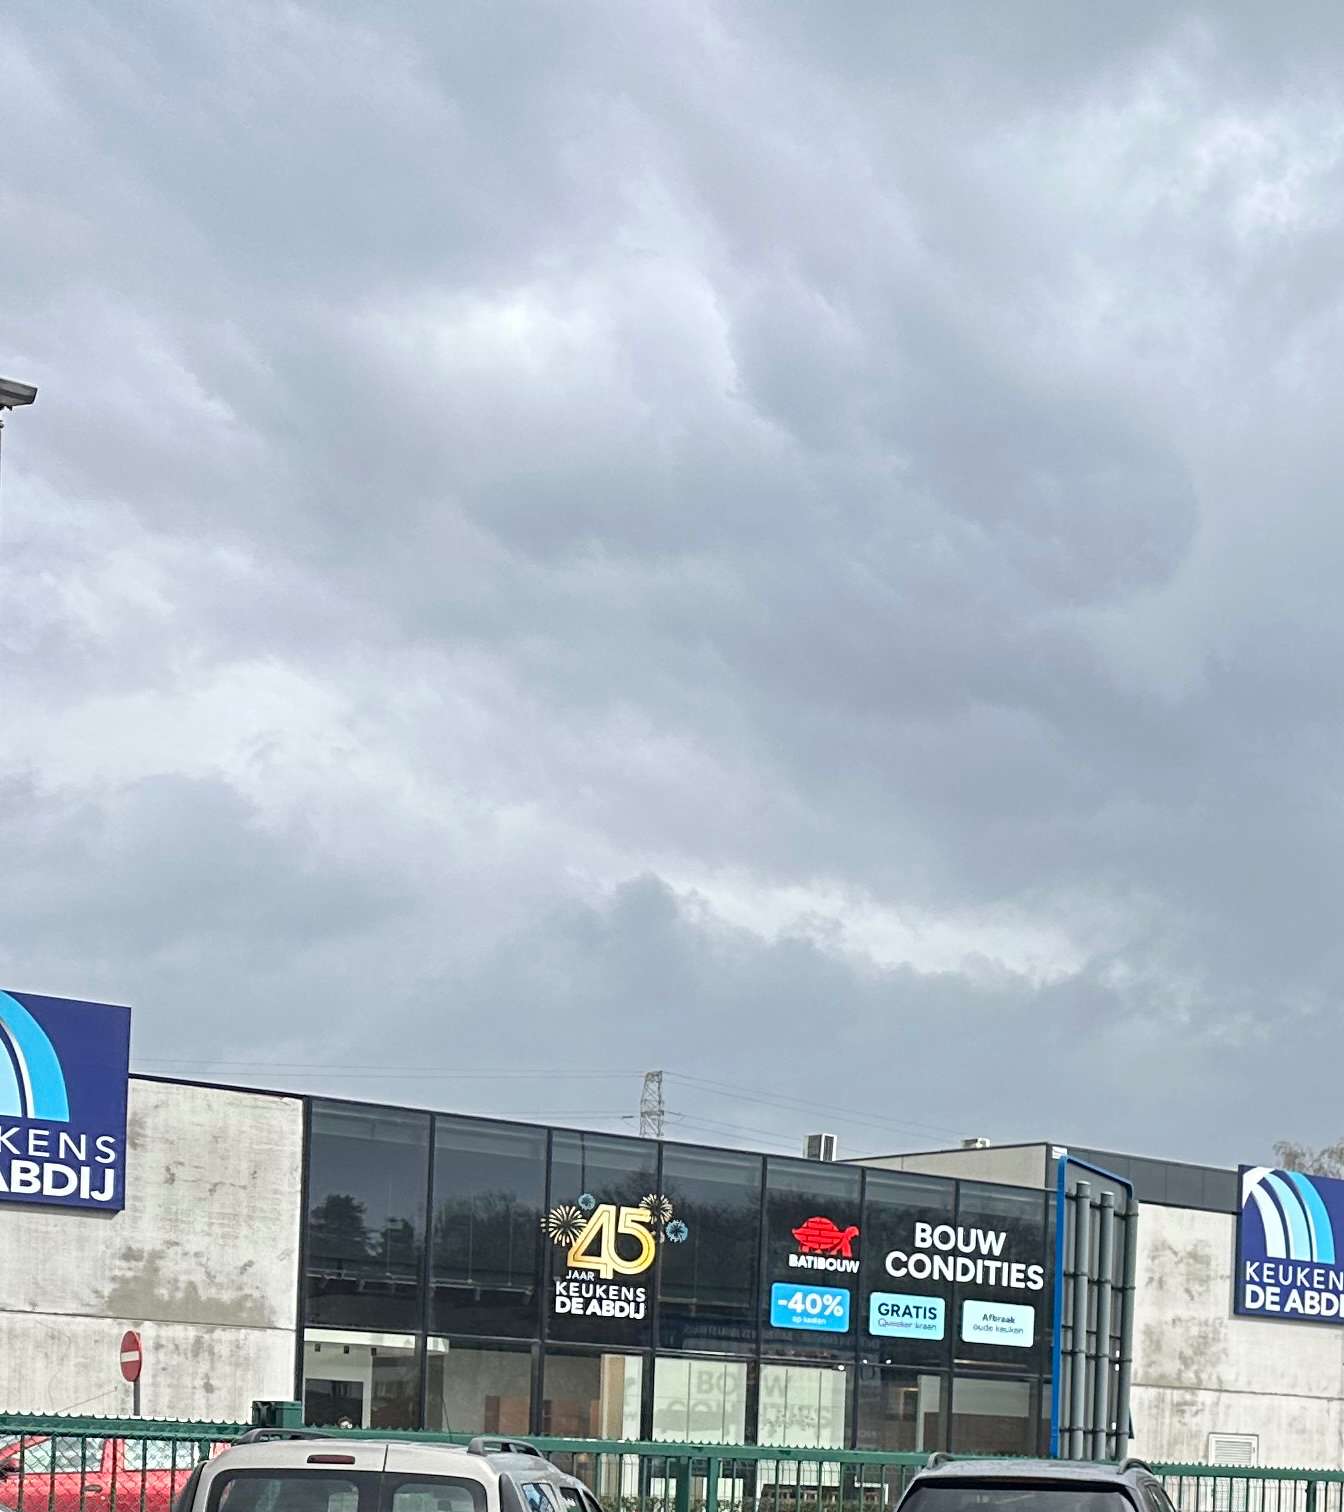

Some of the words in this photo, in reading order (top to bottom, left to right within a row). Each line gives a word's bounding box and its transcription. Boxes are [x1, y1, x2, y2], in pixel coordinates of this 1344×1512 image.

[567, 1204, 656, 1280] 45
[915, 1222, 1006, 1256] BOUW
[566, 1270, 595, 1281] JAAR
[789, 1254, 860, 1274] BATIBOUW
[885, 1251, 1044, 1291] CONDITIES
[555, 1281, 646, 1302] KEUKENS
[778, 1291, 844, 1317] -40%
[1245, 1284, 1281, 1312] DE
[555, 1296, 584, 1315] DE
[586, 1299, 645, 1320] ABDIJ
[878, 1302, 937, 1320] GRATIS
